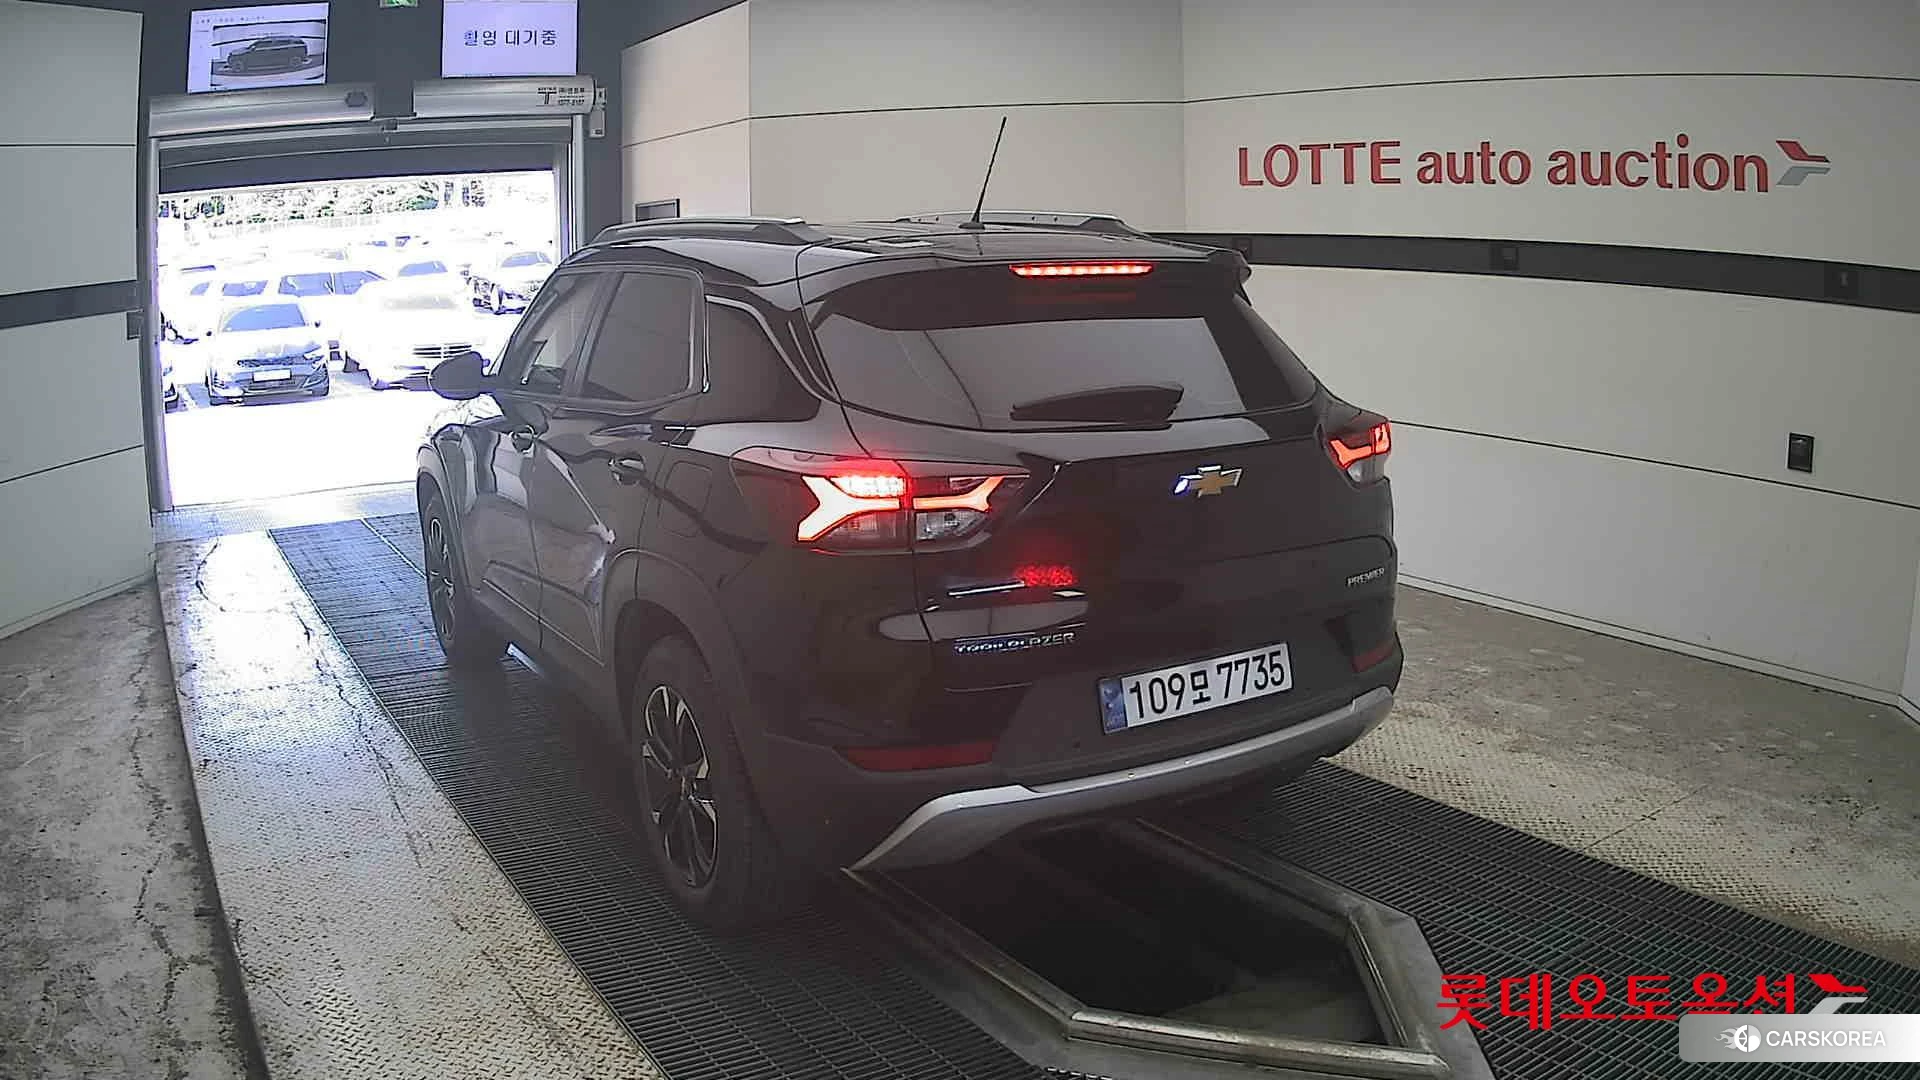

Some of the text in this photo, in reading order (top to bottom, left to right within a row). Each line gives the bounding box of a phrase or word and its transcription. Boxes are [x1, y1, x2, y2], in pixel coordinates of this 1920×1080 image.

[505, 29, 557, 46] 대기중
[1238, 133, 1769, 193] LOTTE auto auction
[1129, 650, 1285, 719] 109모 7735
